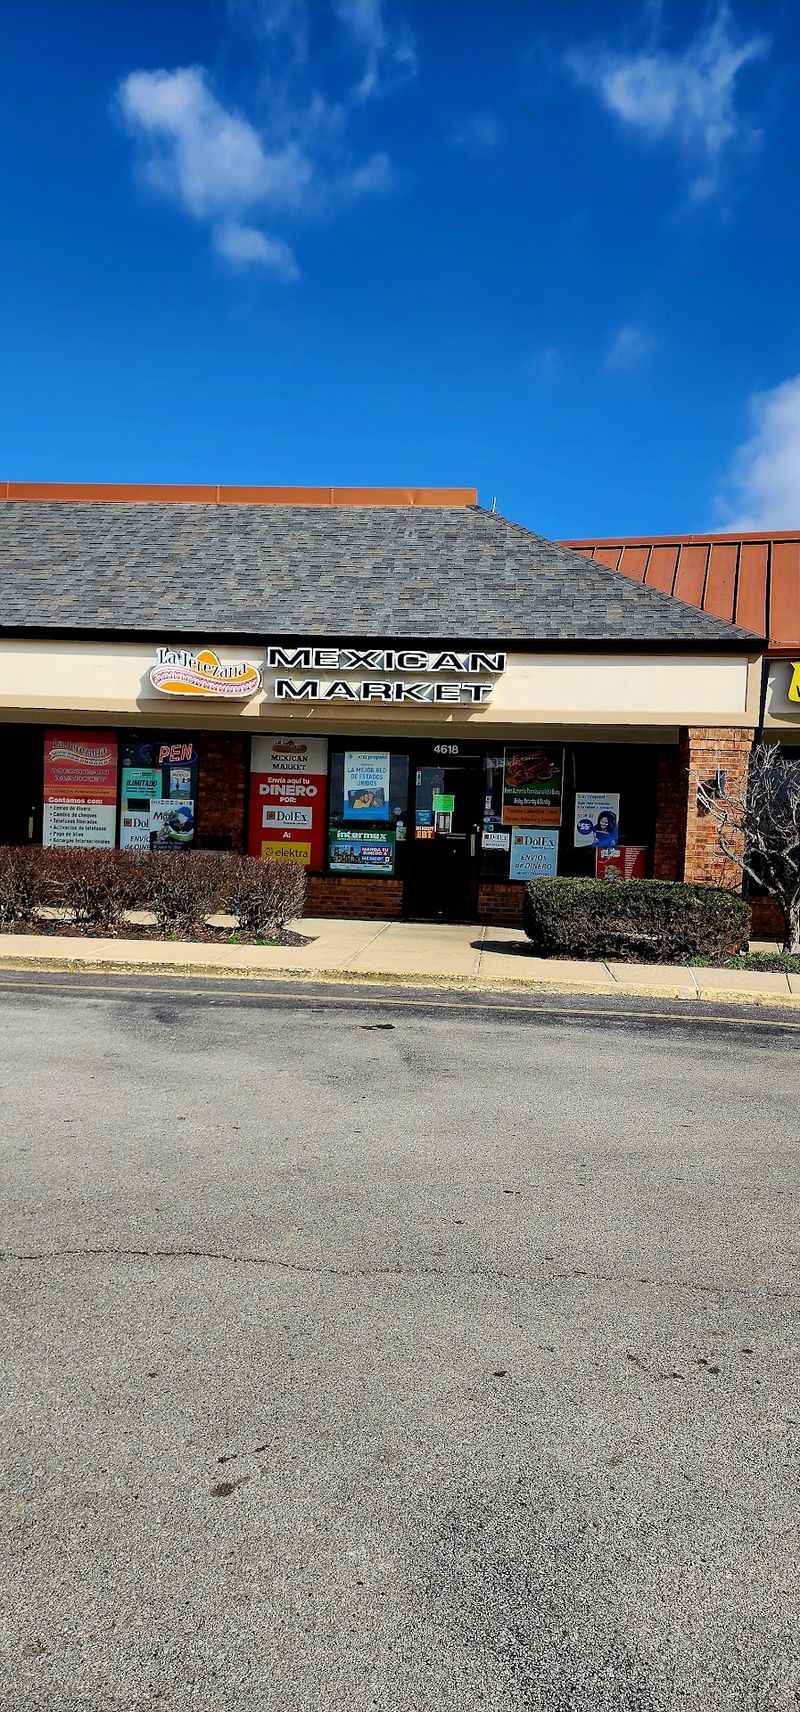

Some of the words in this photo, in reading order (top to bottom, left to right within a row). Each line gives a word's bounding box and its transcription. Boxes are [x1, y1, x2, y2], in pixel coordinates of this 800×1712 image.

[157, 648, 177, 664] La
[267, 647, 507, 672] MEXICAN
[274, 679, 493, 703] MARKET
[434, 744, 459, 754] 4618
[271, 754, 308, 762] MEXICAN
[272, 763, 306, 771] MARKET
[268, 776, 286, 784] Envía
[287, 777, 302, 786] aquí
[259, 783, 318, 797] DINERO
[48, 796, 86, 804] Contamos
[277, 811, 307, 821] DolEx
[283, 831, 291, 839] A:
[336, 830, 387, 839] intermex
[416, 831, 433, 839] EBT
[525, 836, 555, 847] DolEx
[275, 847, 308, 857] elektra
[525, 862, 552, 870] DINERO
